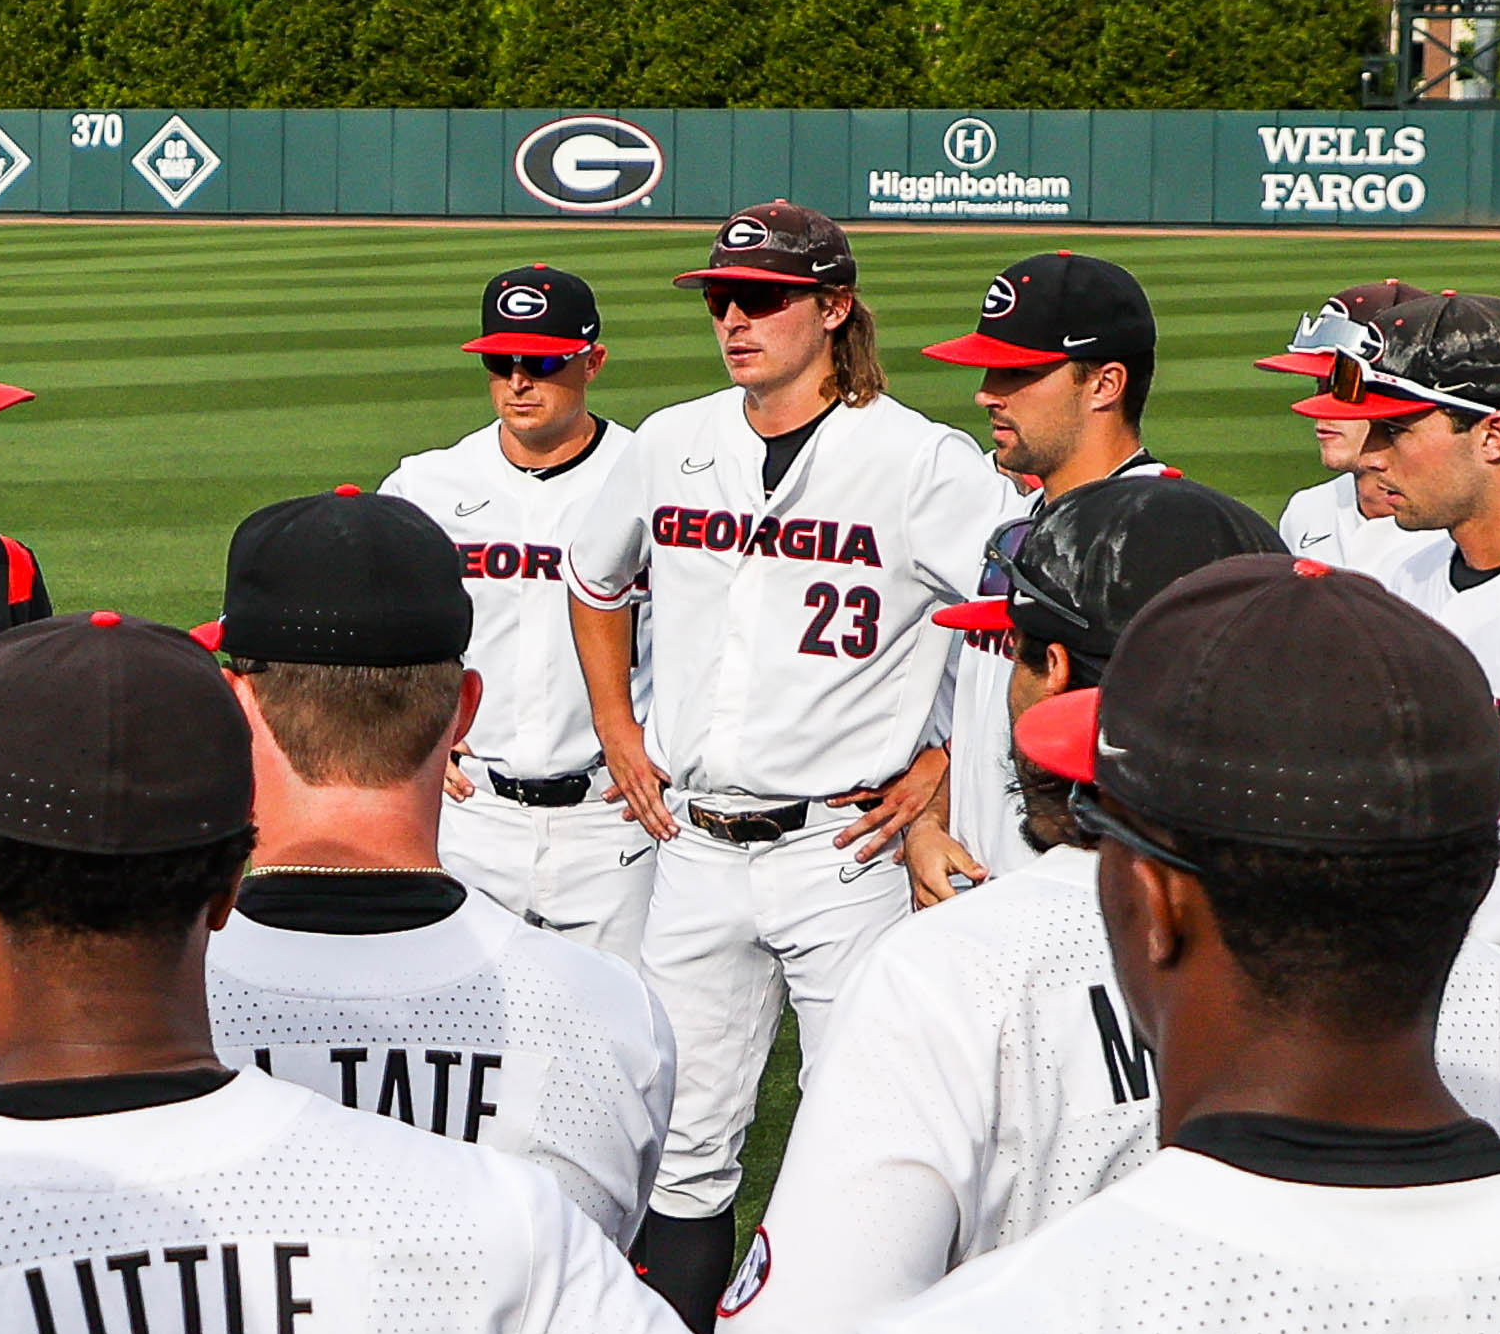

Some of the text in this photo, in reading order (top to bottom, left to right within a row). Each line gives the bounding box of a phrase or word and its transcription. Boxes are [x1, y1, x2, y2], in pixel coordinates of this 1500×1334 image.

[72, 113, 123, 147] 370
[956, 129, 985, 160] H
[1258, 126, 1426, 165] WELLS
[869, 170, 1071, 201] Higginbotham
[1261, 173, 1426, 212] FARGO
[869, 200, 1069, 214] Insurance and Financial Services
[652, 505, 883, 568] GEORGIA
[797, 581, 881, 660] 23
